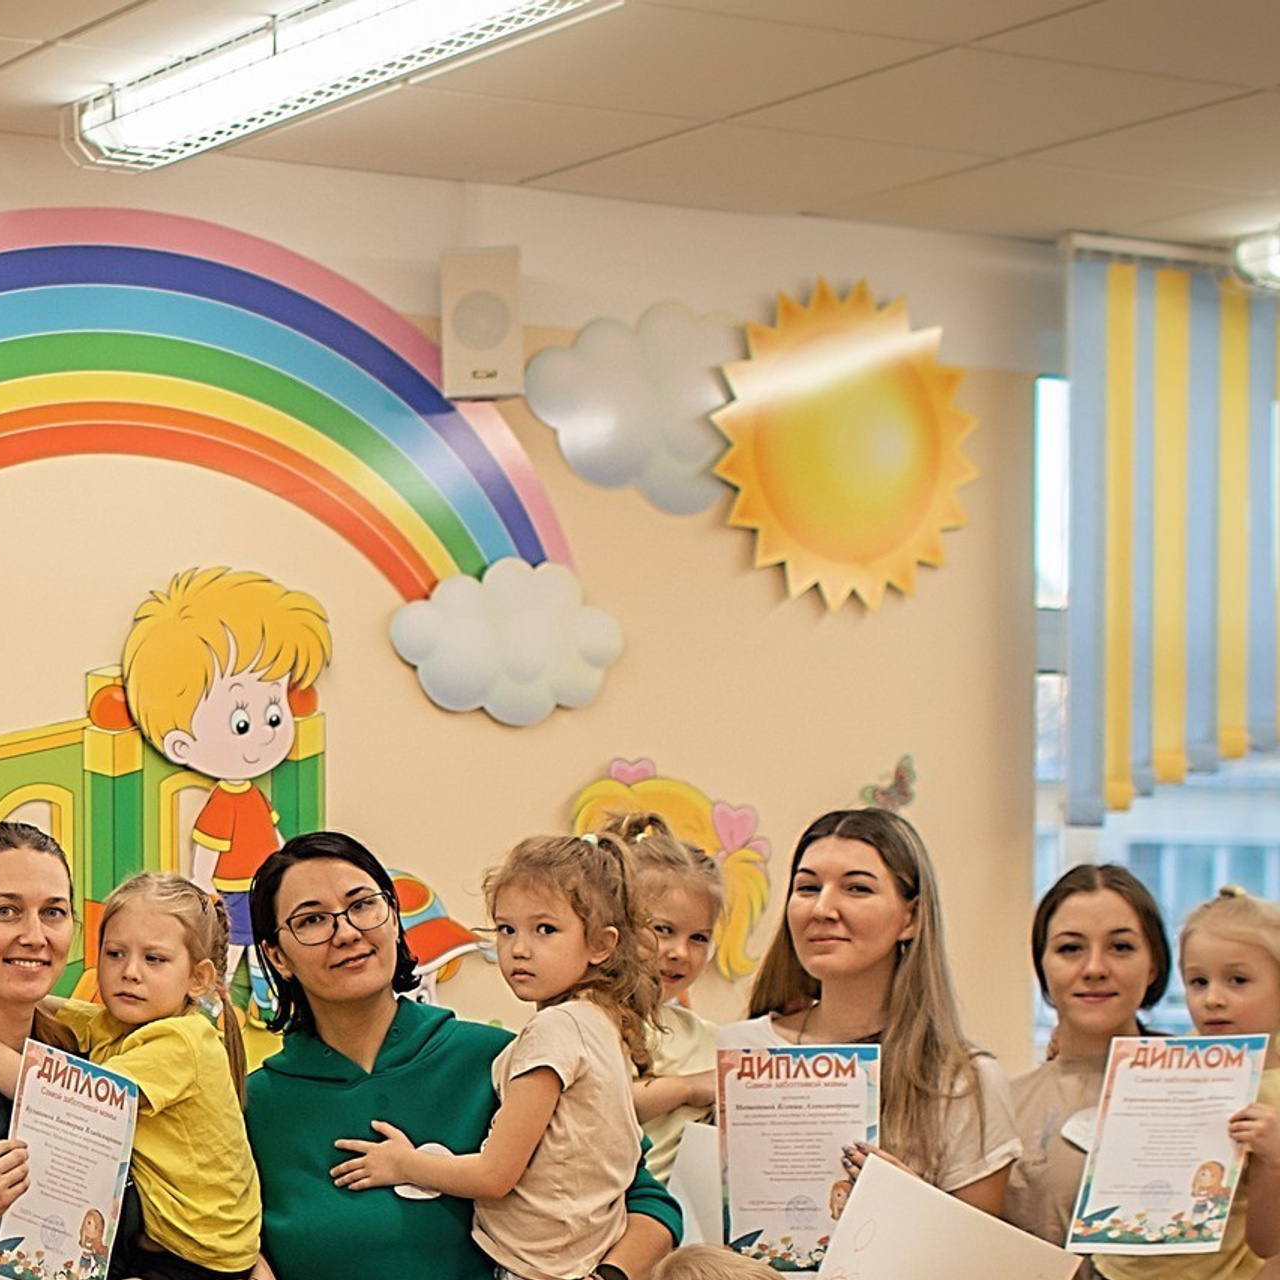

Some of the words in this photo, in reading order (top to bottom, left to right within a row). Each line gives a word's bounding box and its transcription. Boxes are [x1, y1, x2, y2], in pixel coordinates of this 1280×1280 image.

[737, 1055, 857, 1080] ДИПЛОМ
[1129, 1046, 1245, 1069] ДИПЛОМ
[37, 1056, 127, 1110] ДИПЛОМ
[40, 1086, 62, 1100] Самой
